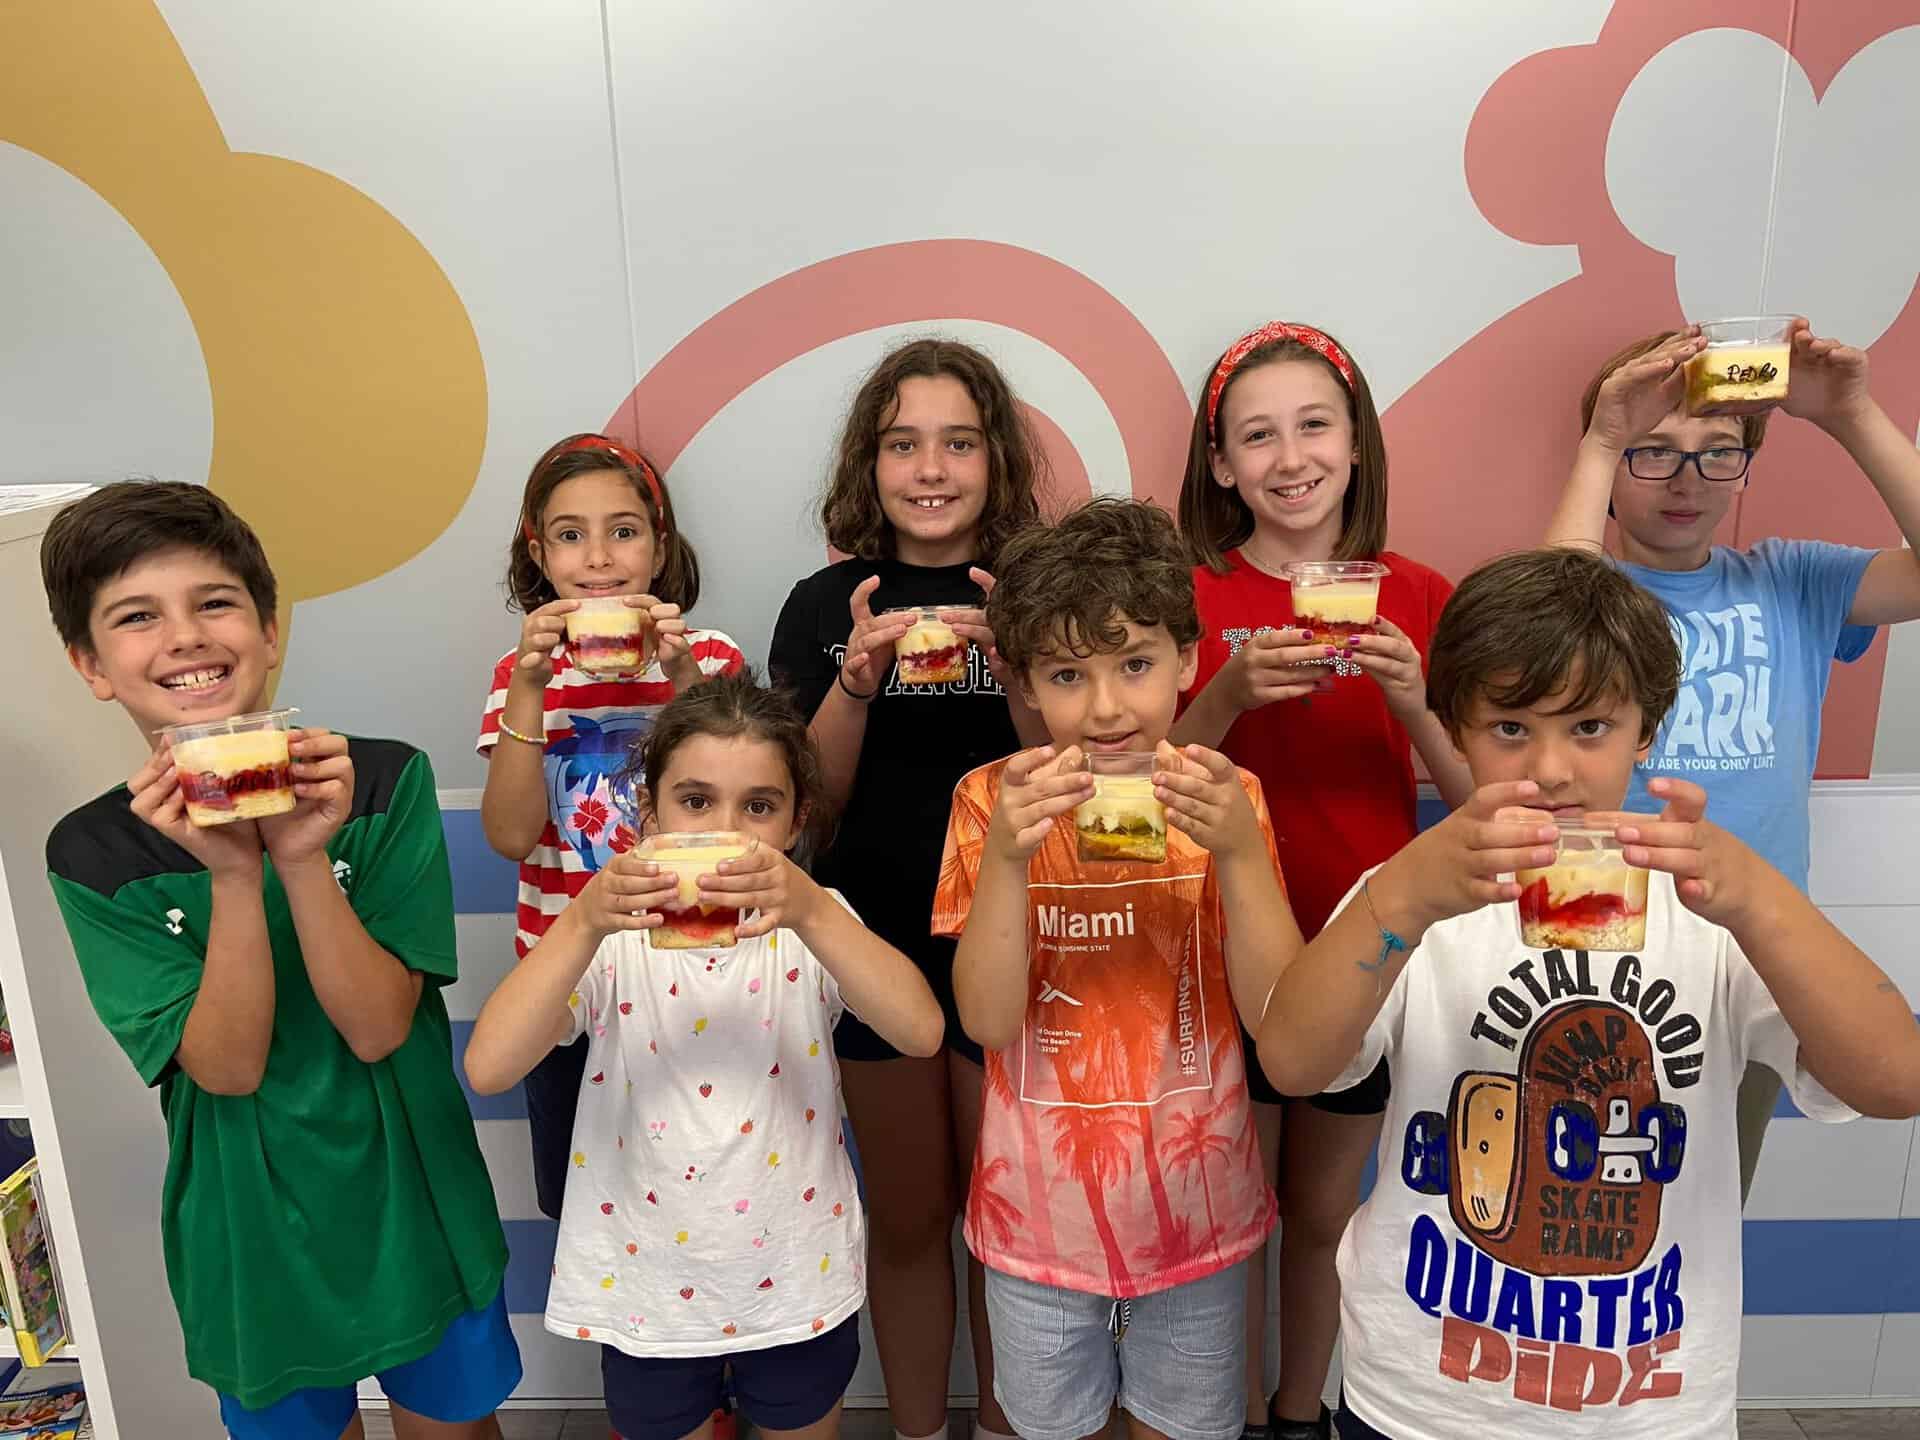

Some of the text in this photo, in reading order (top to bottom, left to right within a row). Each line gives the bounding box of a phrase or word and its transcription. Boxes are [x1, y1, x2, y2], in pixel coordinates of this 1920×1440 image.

[1662, 664, 1775, 757] ARK
[1638, 758, 1654, 770] OU
[1657, 757, 1681, 770] ARE
[1683, 758, 1717, 770] YOUR
[1720, 757, 1750, 770] ONLY
[1037, 903, 1135, 938] Miami
[1090, 944, 1112, 952] STATE
[1470, 949, 1704, 1088] TOTAL GOOD
[1538, 1184, 1641, 1225] SKATE
[1541, 1222, 1635, 1262] RAMP
[1405, 1214, 1685, 1350] QUARTER
